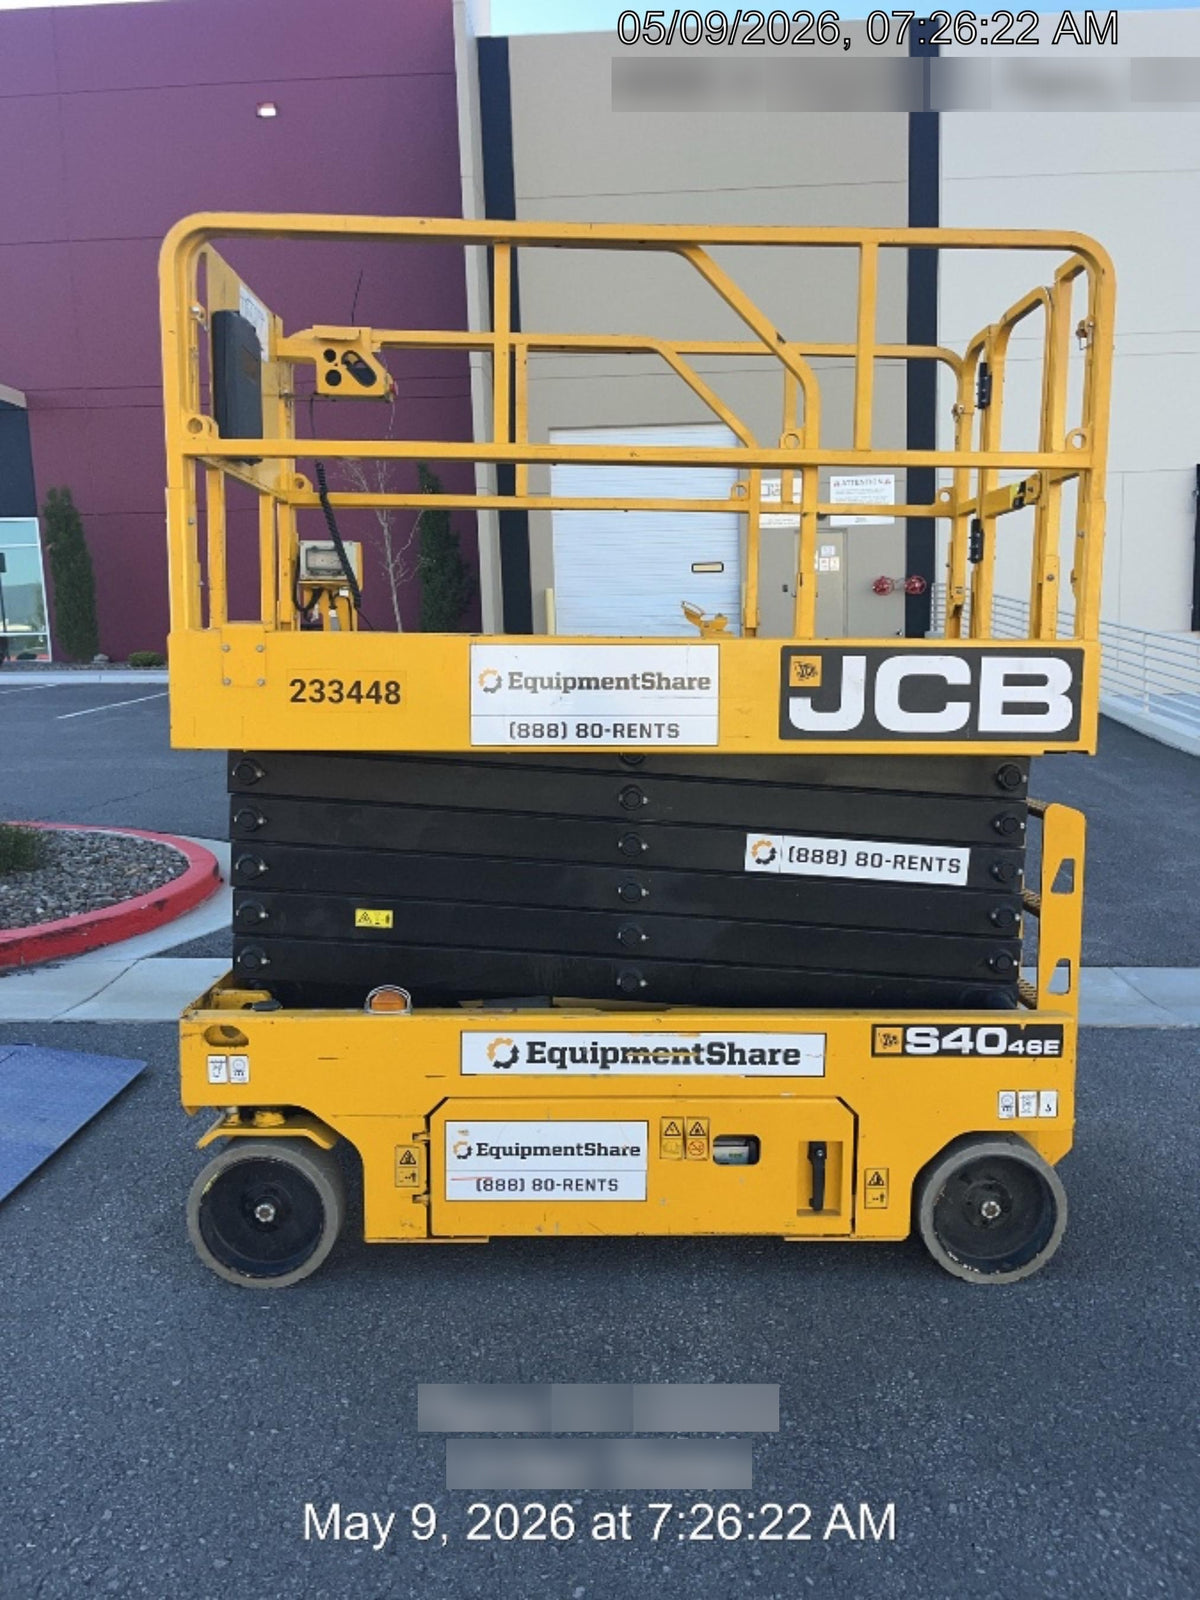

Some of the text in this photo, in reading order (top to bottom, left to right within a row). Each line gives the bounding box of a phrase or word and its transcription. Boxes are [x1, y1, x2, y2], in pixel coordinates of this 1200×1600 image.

[289, 679, 401, 705] 233448
[508, 672, 712, 694] EquipmentShare
[789, 655, 1073, 733] JCB
[509, 721, 680, 740] (888) 80-RENTS
[788, 846, 961, 874] (888) 80-RENTS
[526, 1041, 801, 1070] EquipmentShare
[475, 1142, 641, 1160] EquipmentShare
[475, 1178, 619, 1192] (888) 80-RENTS
